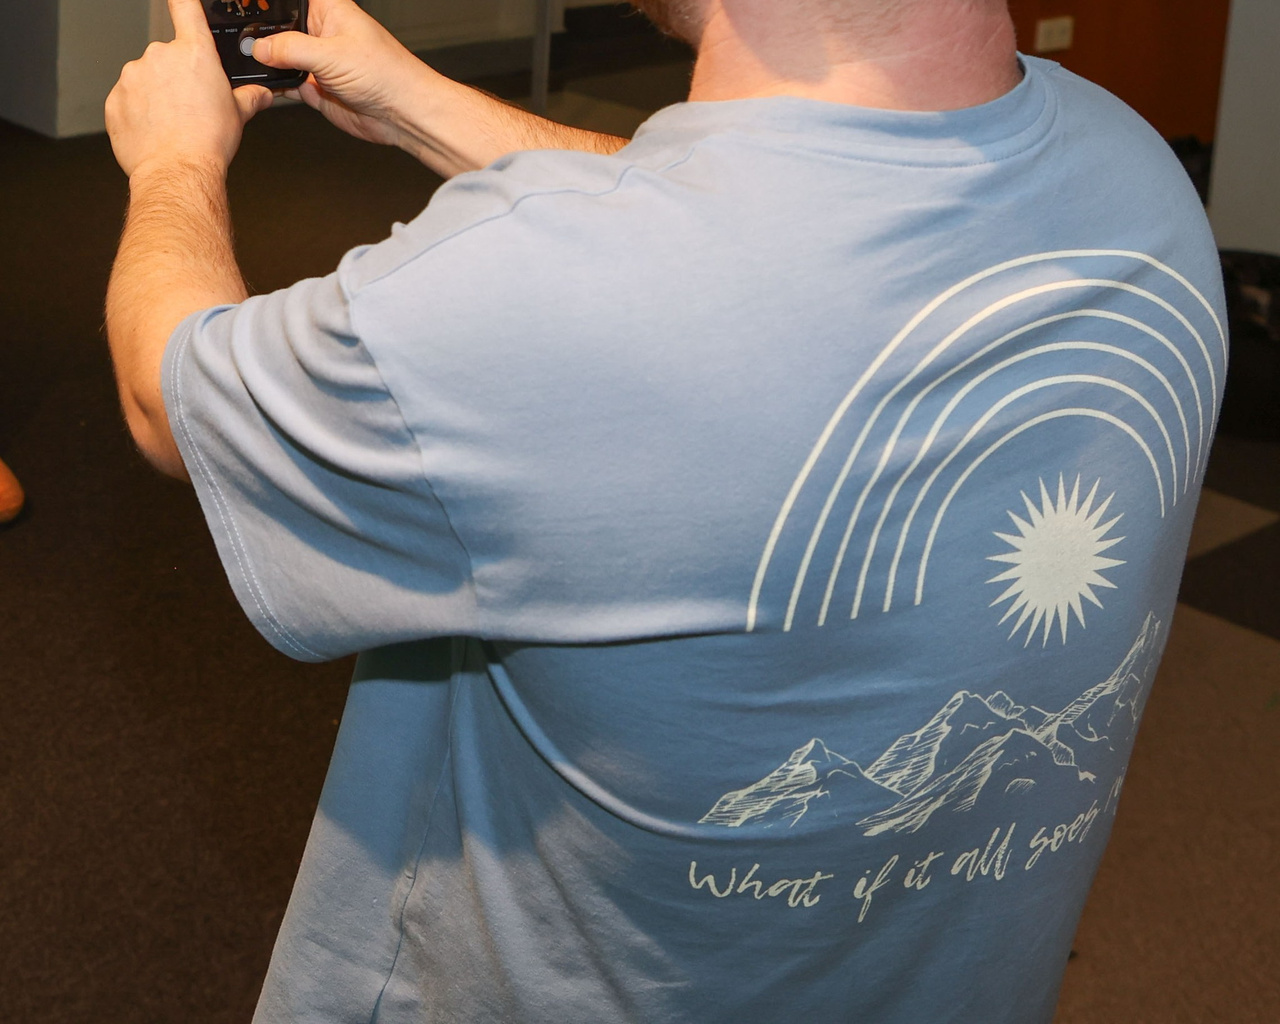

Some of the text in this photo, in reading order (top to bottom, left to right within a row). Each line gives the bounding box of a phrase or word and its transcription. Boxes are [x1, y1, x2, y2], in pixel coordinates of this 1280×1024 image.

[688, 861, 835, 909] What
[853, 855, 900, 924] if
[904, 849, 945, 891] it
[951, 822, 1016, 883] all
